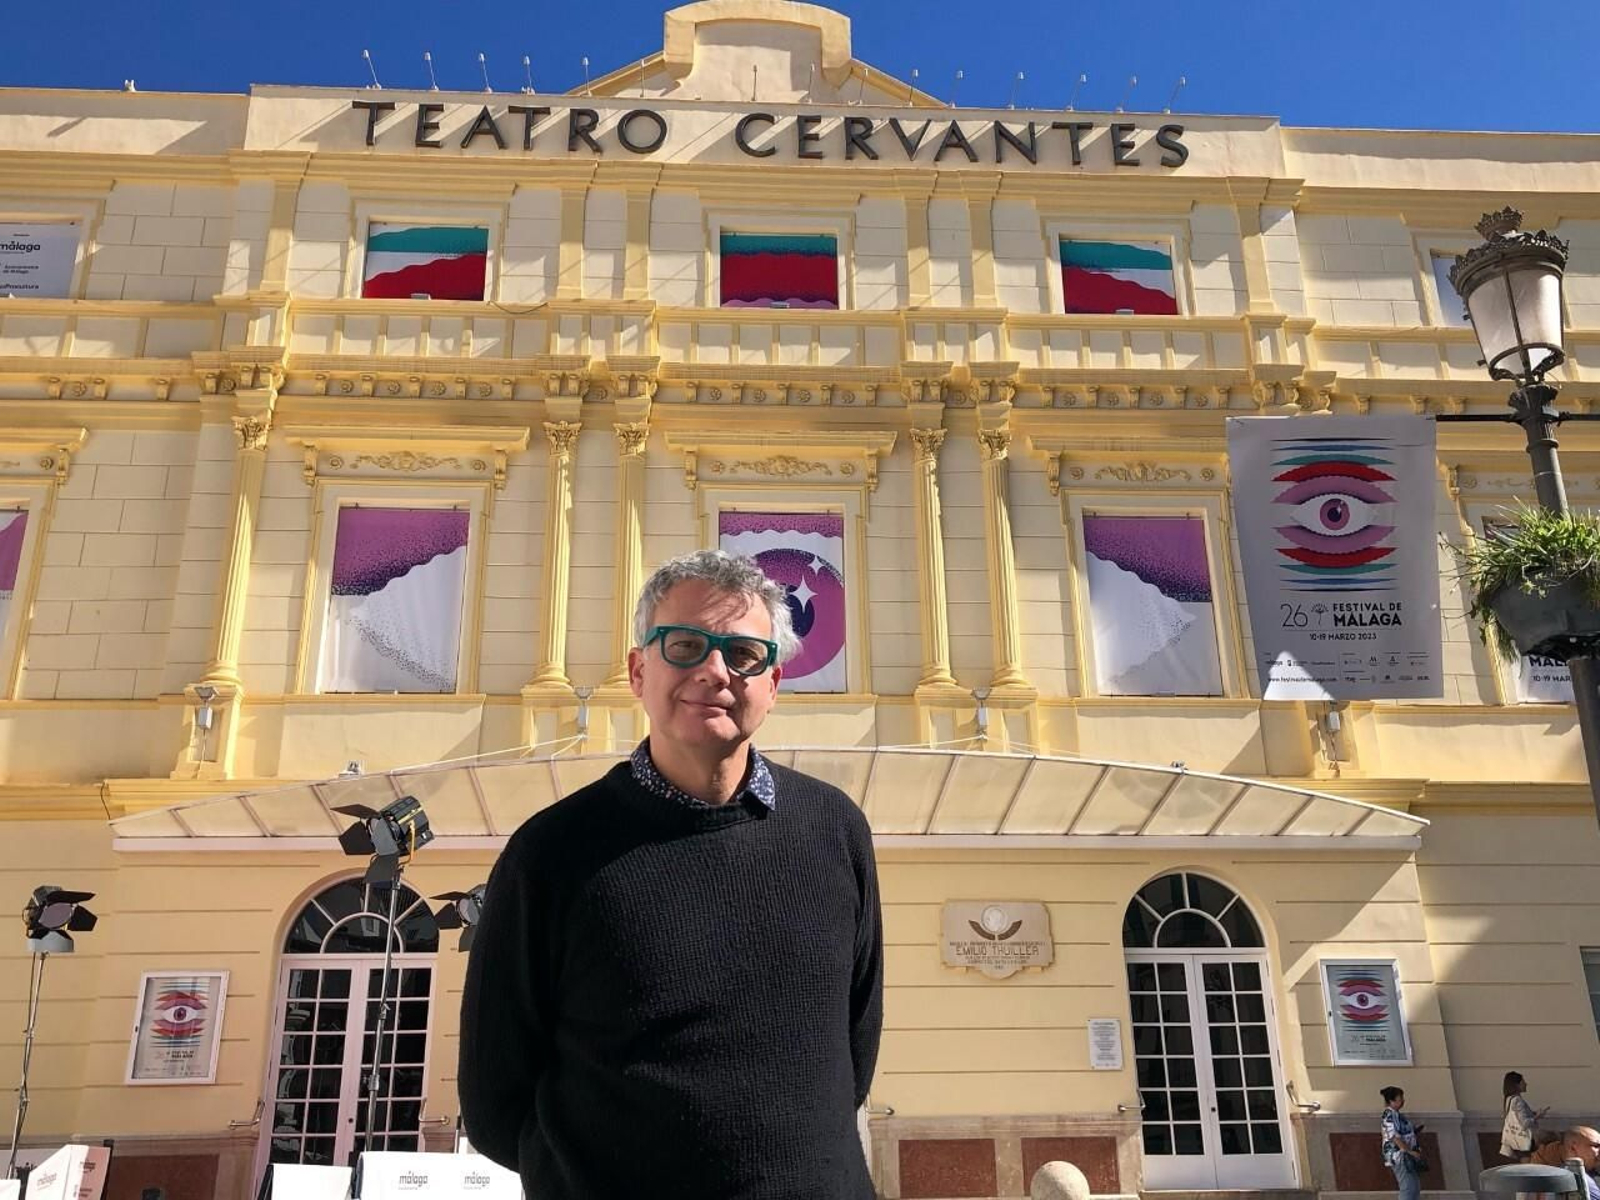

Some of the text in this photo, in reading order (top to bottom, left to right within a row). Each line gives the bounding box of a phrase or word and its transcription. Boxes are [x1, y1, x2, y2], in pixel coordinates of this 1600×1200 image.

[352, 101, 1189, 167] TEATRO CERVANTES
[1280, 602, 1402, 627] 26 FESTIVAL DE
[1328, 633, 1356, 641] MARZO
[1358, 632, 1377, 640] 2023
[1529, 655, 1568, 667] MAL
[1552, 675, 1572, 683] MAR
